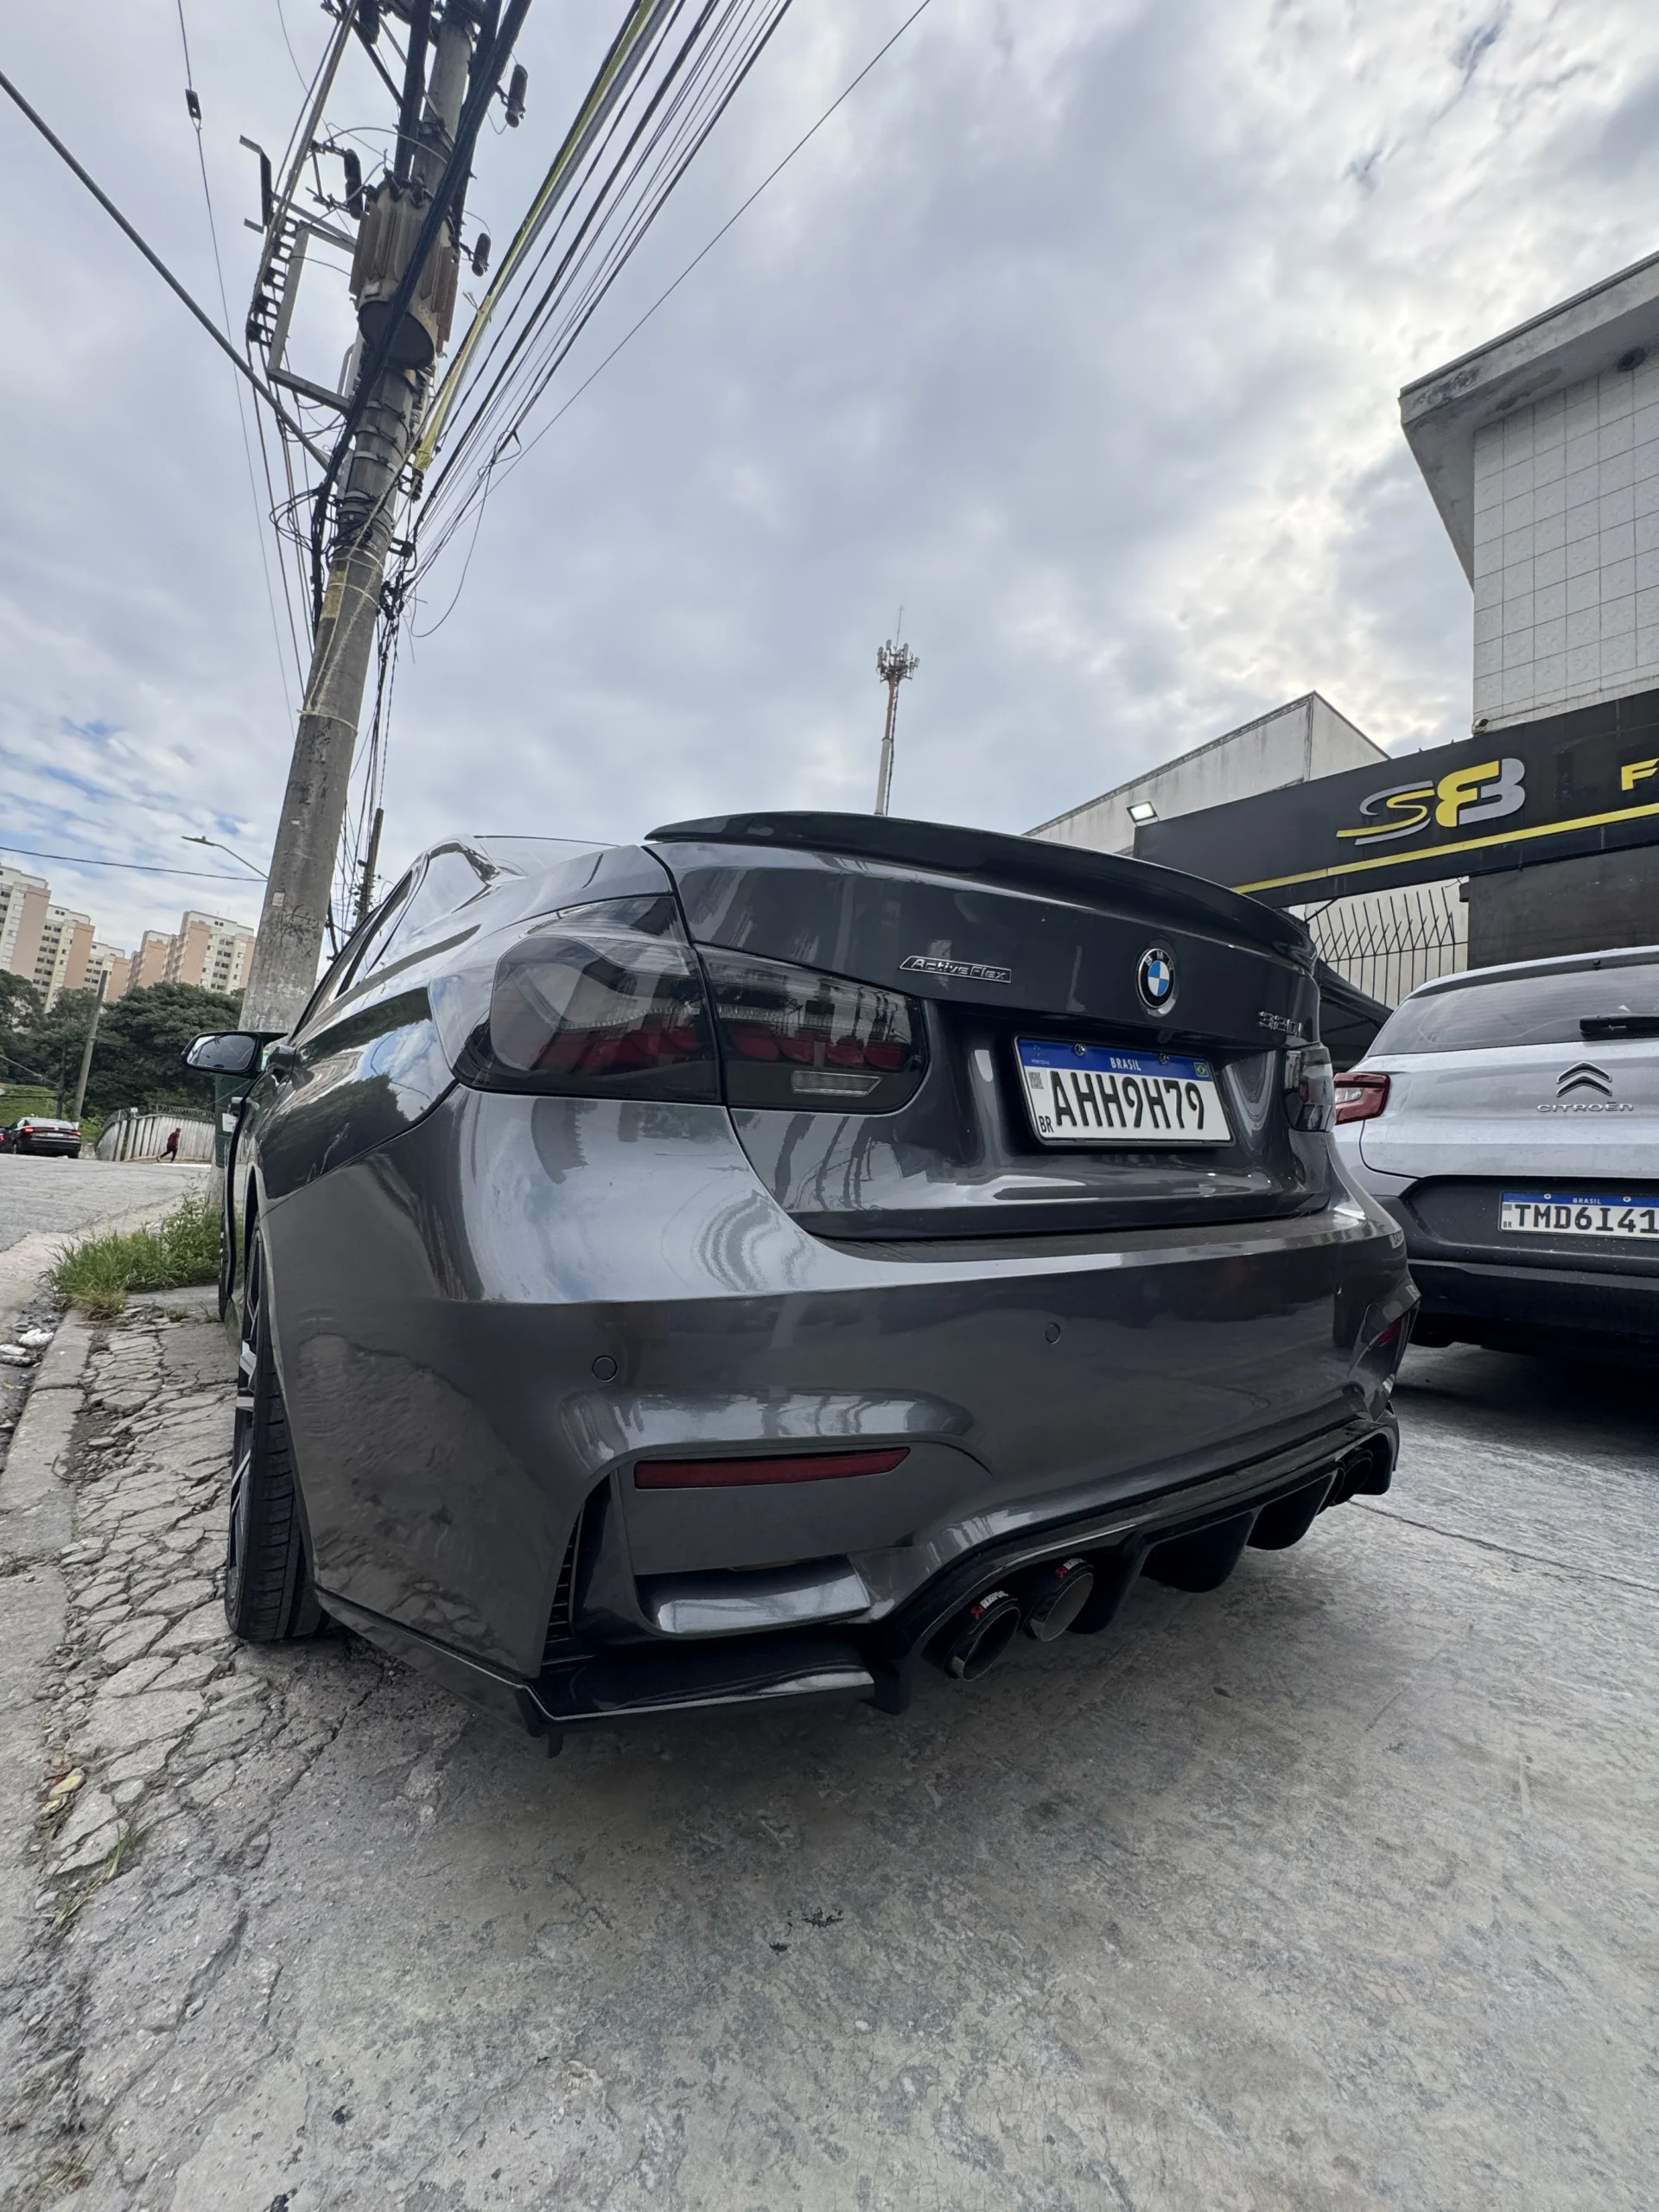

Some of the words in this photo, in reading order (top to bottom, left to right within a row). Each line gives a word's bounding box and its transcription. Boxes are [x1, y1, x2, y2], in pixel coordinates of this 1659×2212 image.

[1144, 950, 1175, 970] BMW
[1109, 1057, 1142, 1071] BRASIL
[1050, 1071, 1205, 1130] AHH9H79
[1038, 1116, 1054, 1134] BR
[1503, 1220, 1512, 1229] BR
[1515, 1204, 1659, 1234] TMD6I41
